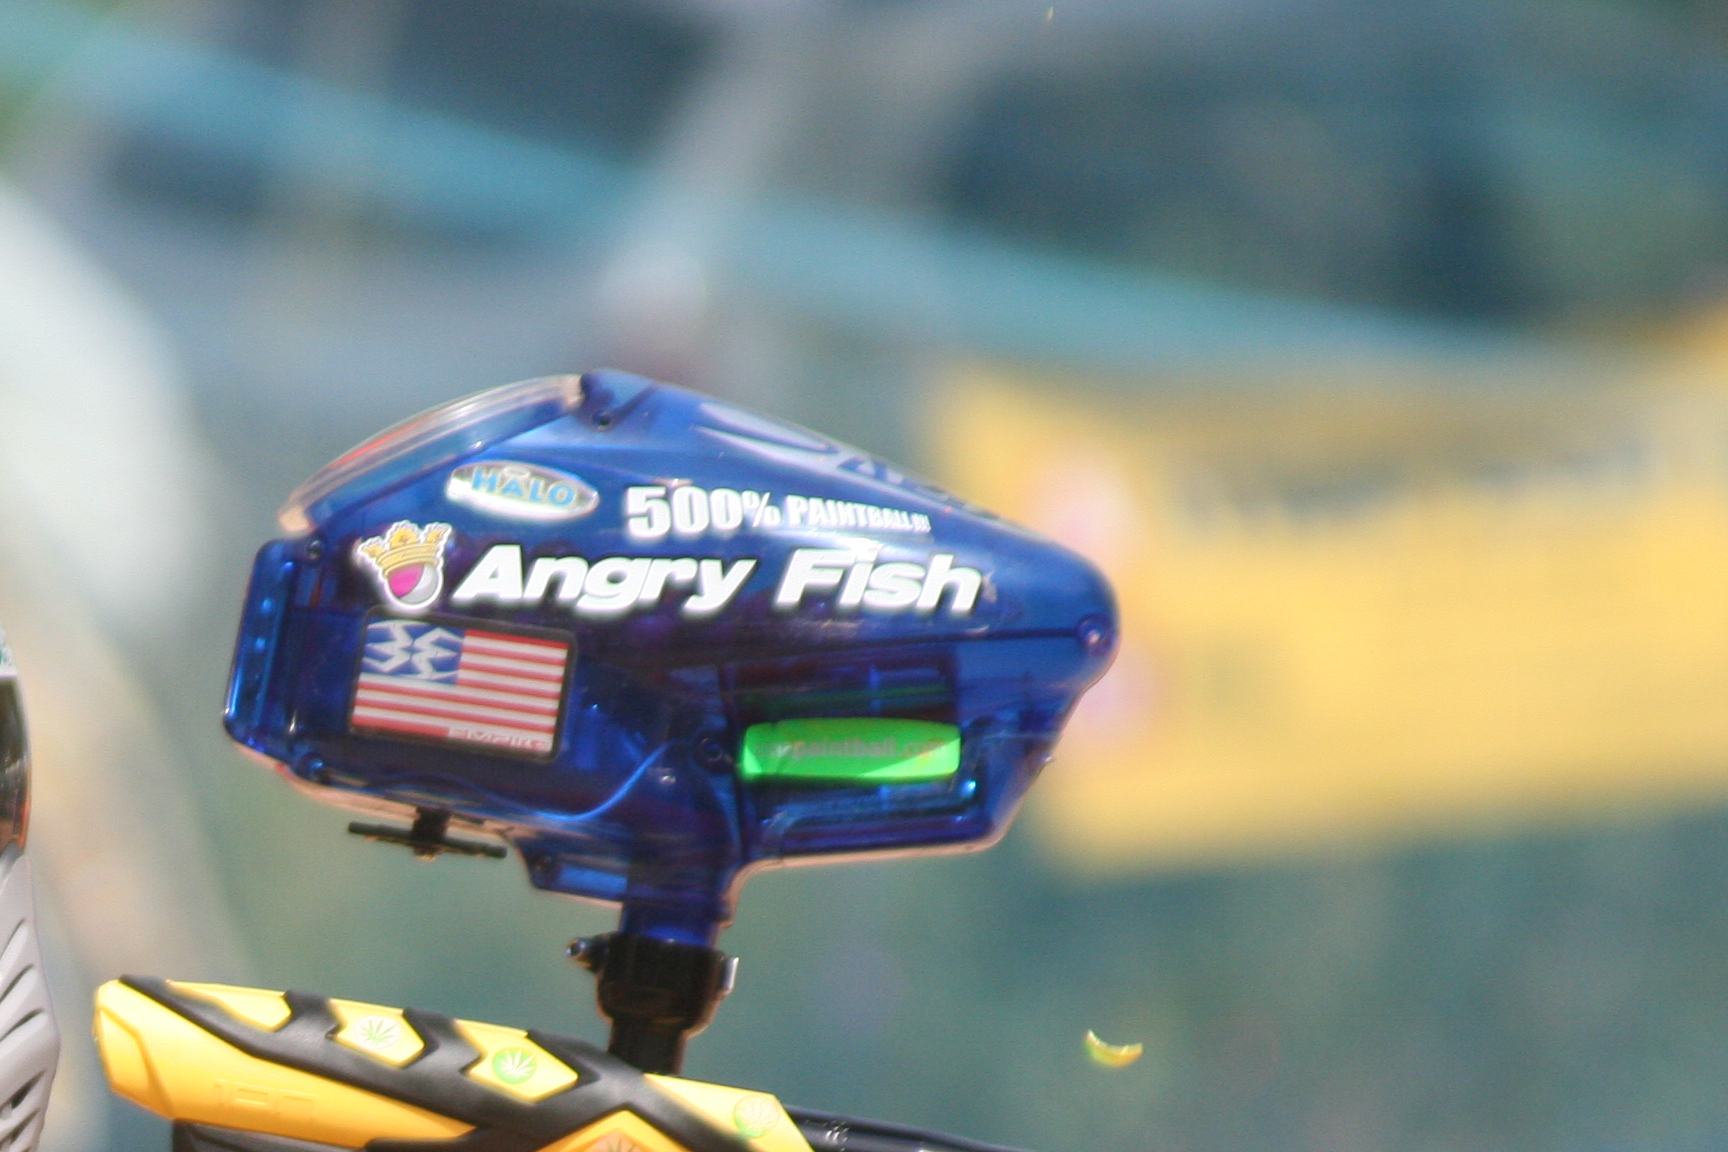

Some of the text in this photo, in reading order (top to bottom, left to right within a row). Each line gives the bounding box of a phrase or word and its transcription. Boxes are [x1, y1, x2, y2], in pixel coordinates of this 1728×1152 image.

[471, 468, 576, 508] HALO
[627, 485, 782, 540] 500%
[453, 544, 986, 616] Angry Fish
